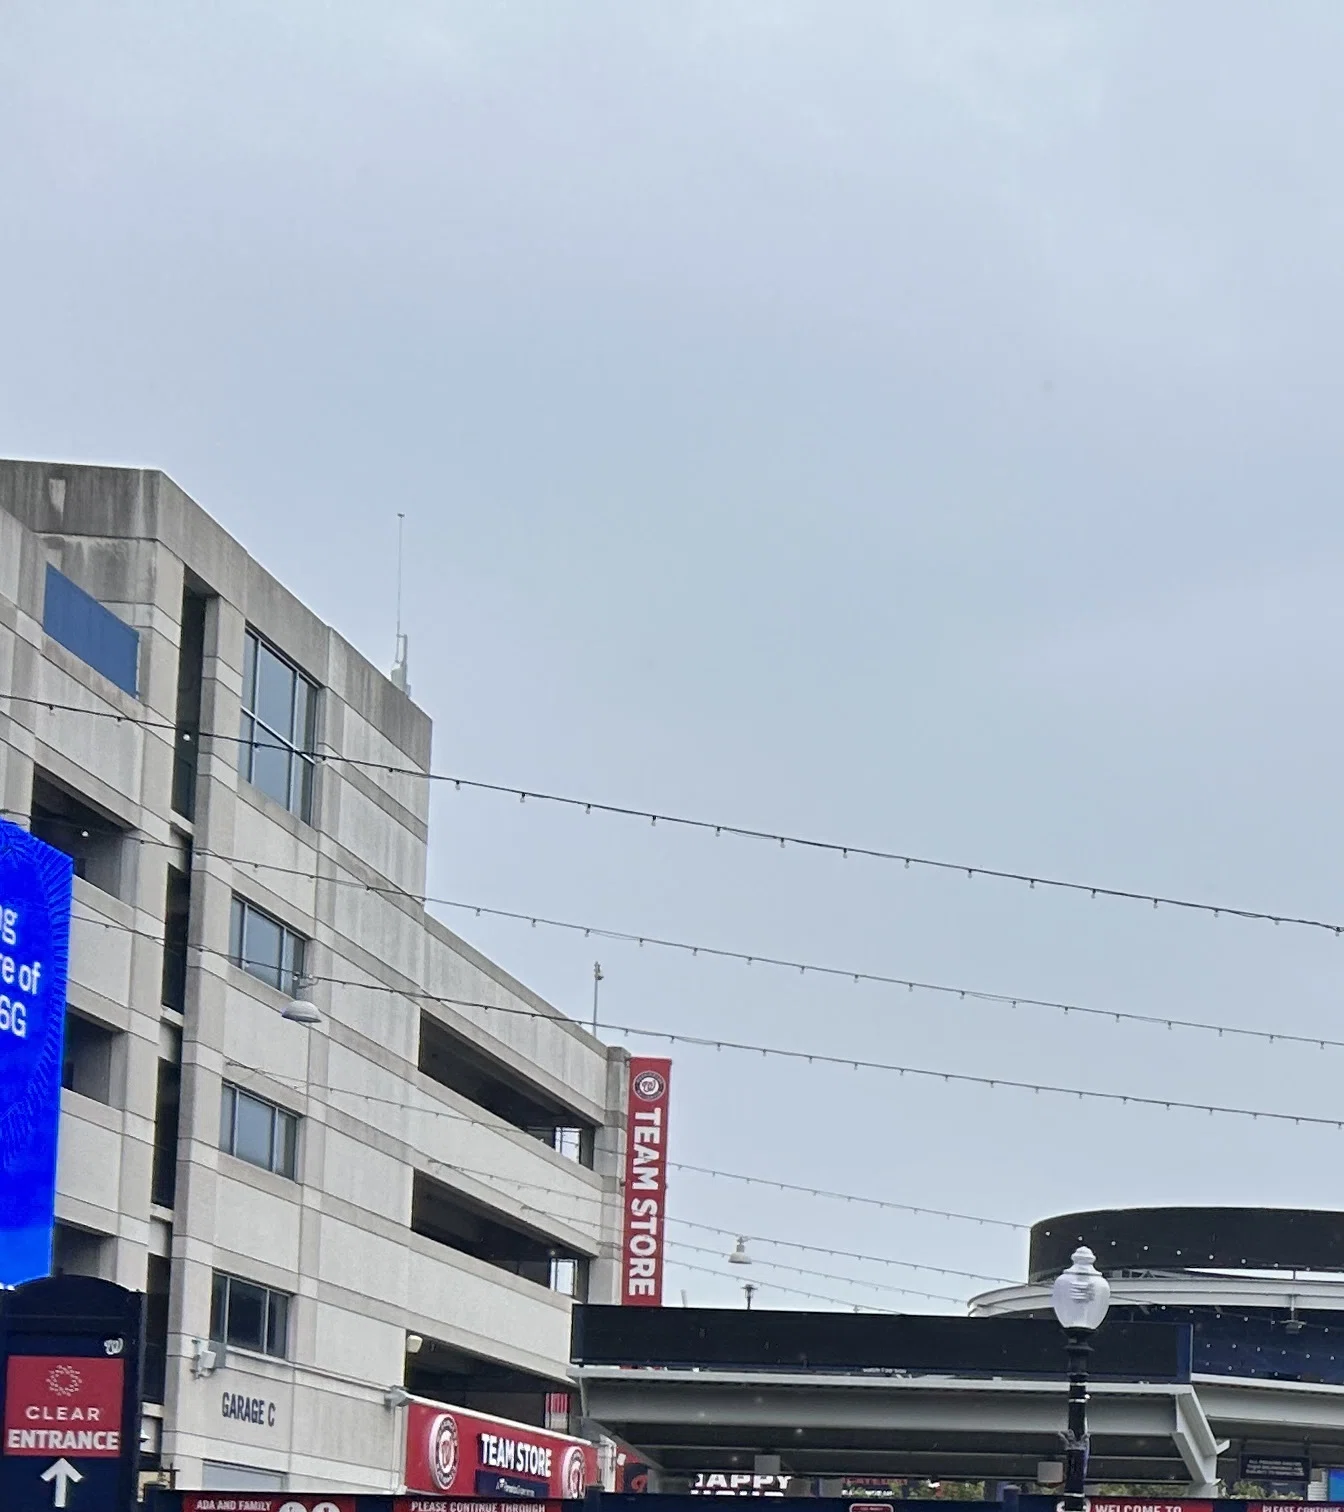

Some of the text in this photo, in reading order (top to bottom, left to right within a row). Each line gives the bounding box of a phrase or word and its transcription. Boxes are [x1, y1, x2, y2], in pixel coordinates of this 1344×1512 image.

[19, 961, 41, 995] of
[629, 1107, 661, 1297] TEAM STORE
[25, 1405, 100, 1421] CLEAR
[221, 1391, 276, 1427] GARAGE C
[8, 1429, 119, 1450] ENTRANCE
[481, 1434, 552, 1477] TEAM STORE
[217, 1500, 236, 1511] AND
[411, 1501, 447, 1512] PLEASE
